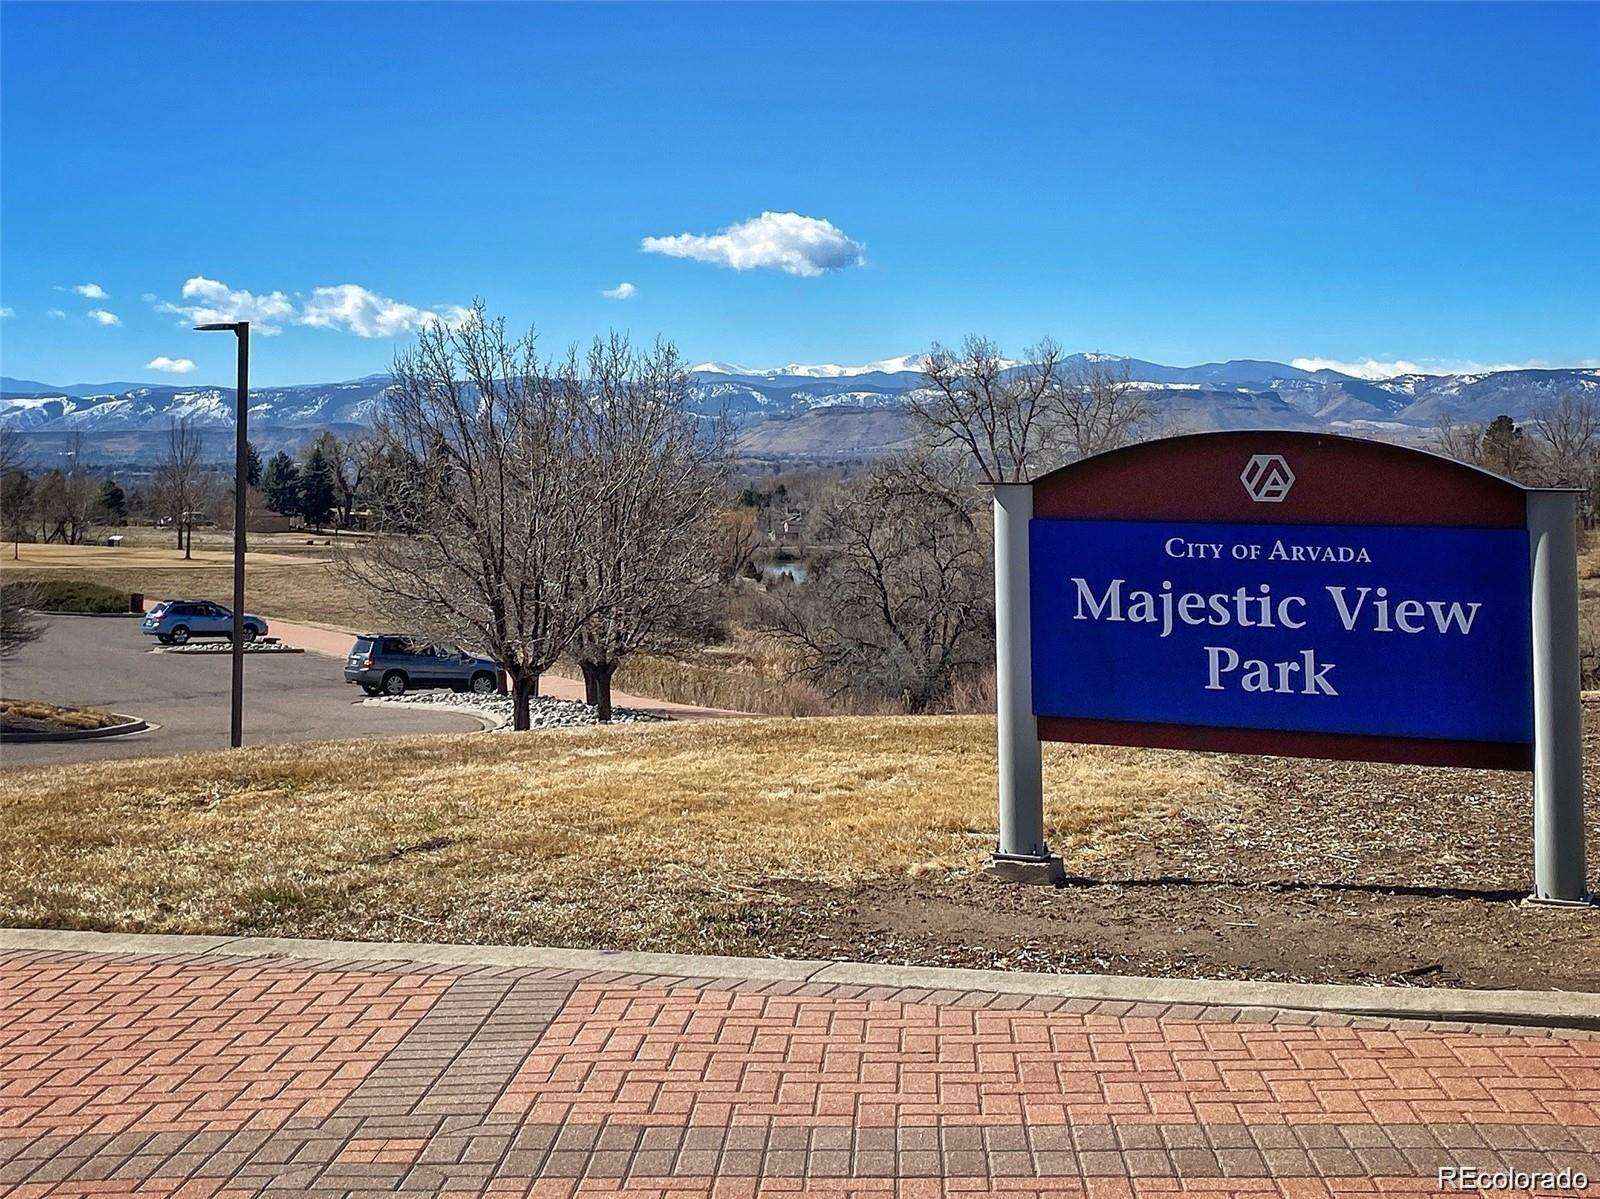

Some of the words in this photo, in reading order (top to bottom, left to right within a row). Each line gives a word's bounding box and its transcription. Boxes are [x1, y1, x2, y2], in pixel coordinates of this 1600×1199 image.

[1165, 537, 1223, 560] CITY
[1232, 544, 1261, 560] OF
[1268, 539, 1372, 563] ARVADA
[1070, 577, 1307, 637] Majestic
[1325, 586, 1482, 635] View
[1203, 646, 1338, 696] Park
